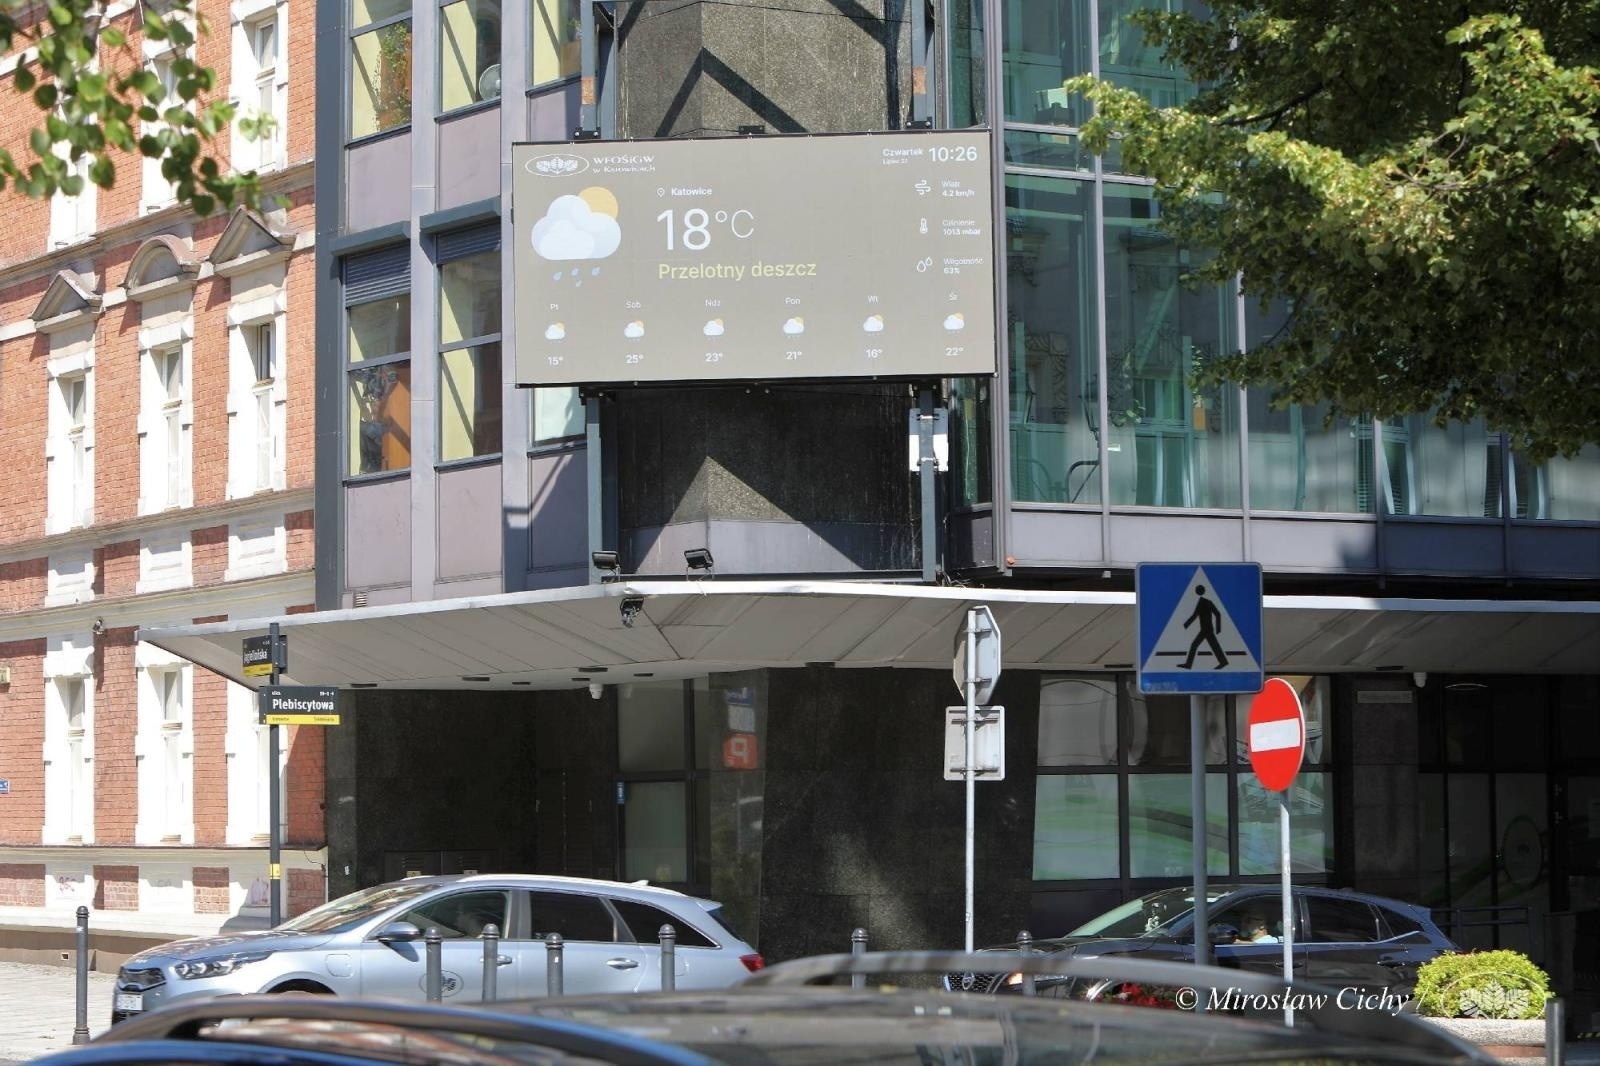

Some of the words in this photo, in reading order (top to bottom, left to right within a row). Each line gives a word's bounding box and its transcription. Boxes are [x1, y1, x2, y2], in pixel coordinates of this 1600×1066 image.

[882, 147, 923, 157] Czwartek
[928, 146, 978, 162] 10:26
[671, 187, 713, 197] Katowice
[656, 208, 755, 251] 18°C
[658, 263, 746, 282] Przelotny
[751, 261, 818, 277] deszcz
[625, 300, 641, 309] Sob
[785, 297, 801, 306] Pon
[705, 352, 723, 362] 23°
[786, 351, 803, 361] 21°
[865, 348, 883, 359] 16°
[945, 347, 964, 357] 22°
[626, 354, 644, 364] 25°
[272, 698, 335, 713] Plebiscytowa
